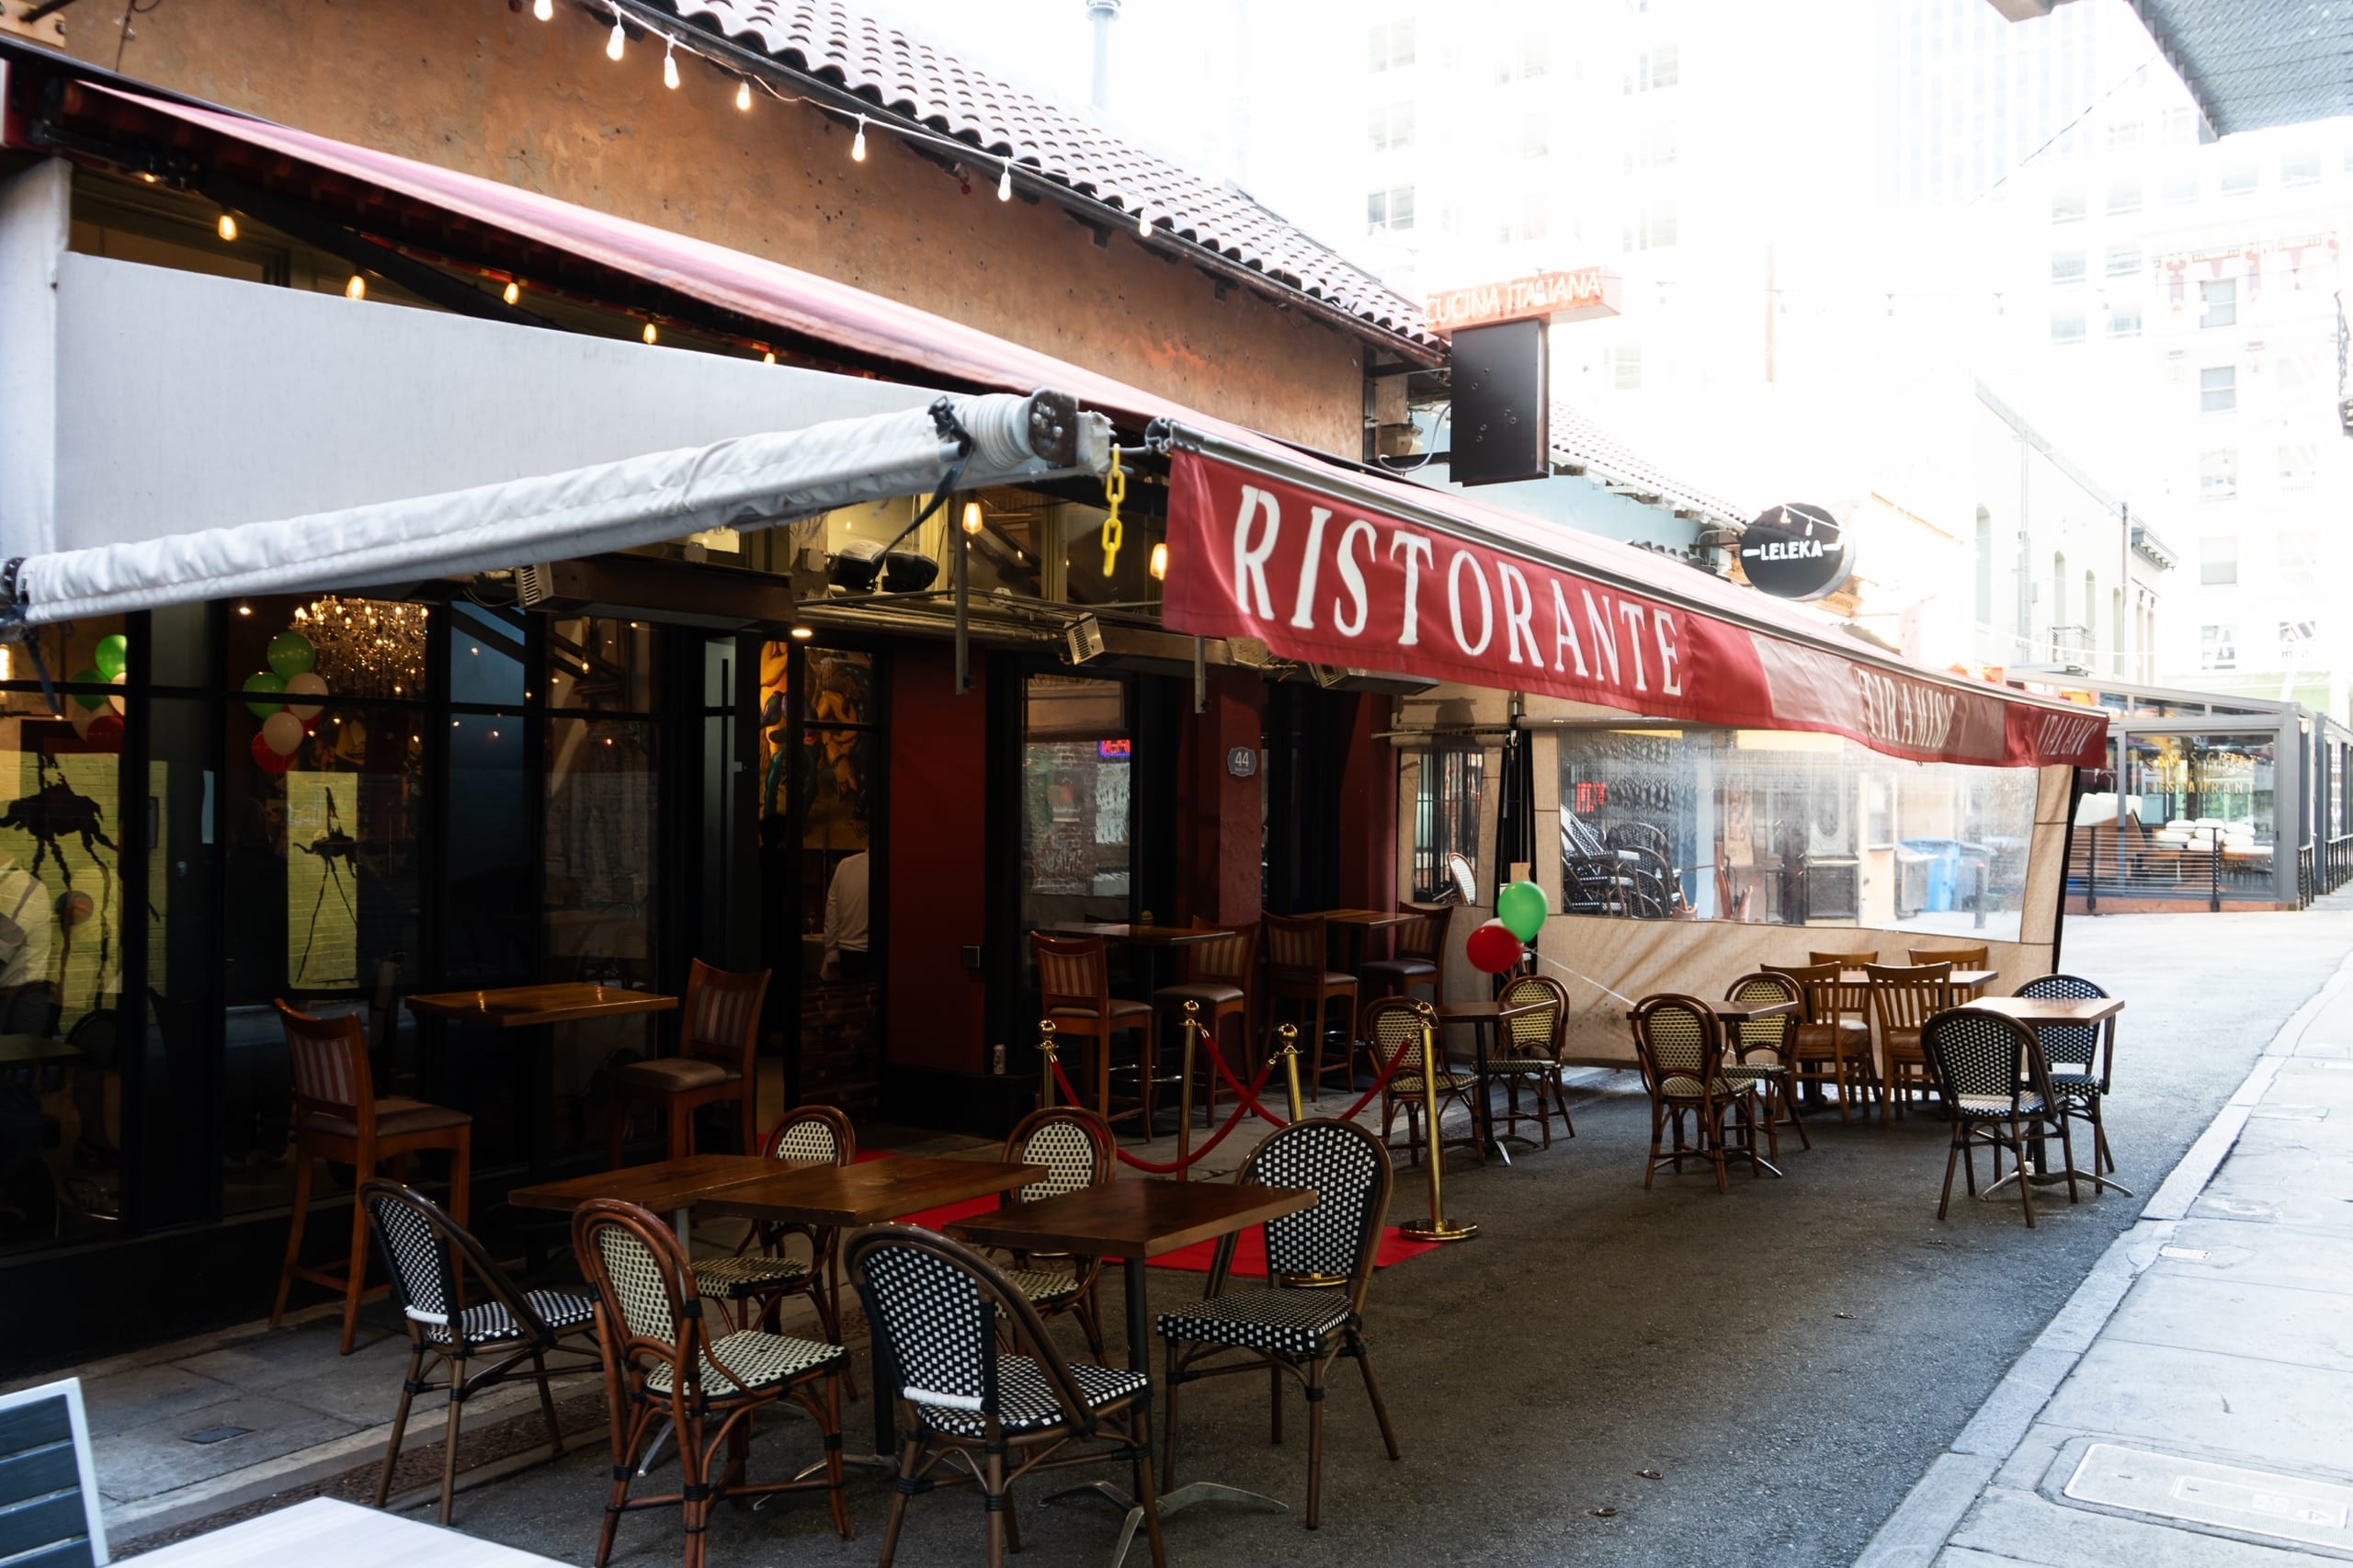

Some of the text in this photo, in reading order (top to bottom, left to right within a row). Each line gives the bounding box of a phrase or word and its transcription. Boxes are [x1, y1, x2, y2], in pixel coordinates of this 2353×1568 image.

[1760, 540, 1824, 561] LELEKA
[1232, 483, 1682, 697] RISTORANTE
[1854, 666, 1955, 749] TIRAMISU
[1234, 751, 1249, 767] 44
[2145, 781, 2256, 794] RESTAURANT
